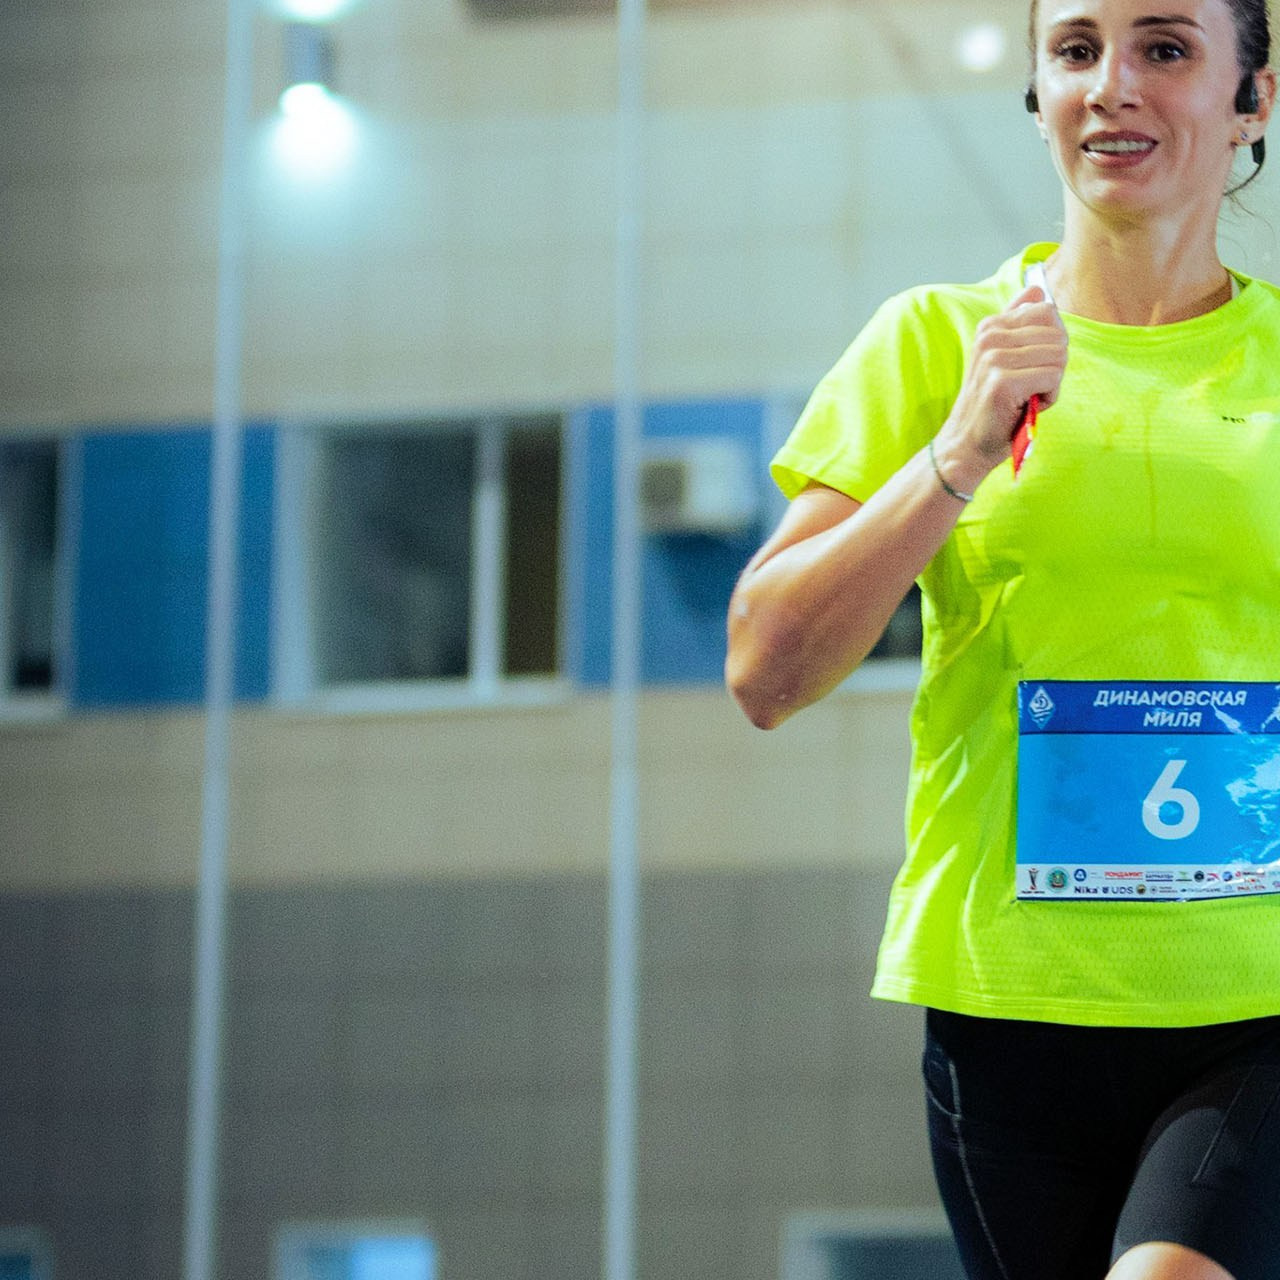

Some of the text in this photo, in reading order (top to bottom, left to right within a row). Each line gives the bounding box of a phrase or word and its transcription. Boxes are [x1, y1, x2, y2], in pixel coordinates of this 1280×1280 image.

[1094, 689, 1247, 707] ДИНАМОВСКАЯ
[1143, 711, 1202, 727] МИЛЯ
[1142, 759, 1200, 841] 6
[1074, 886, 1098, 894] Nika
[1111, 886, 1134, 895] UDS
